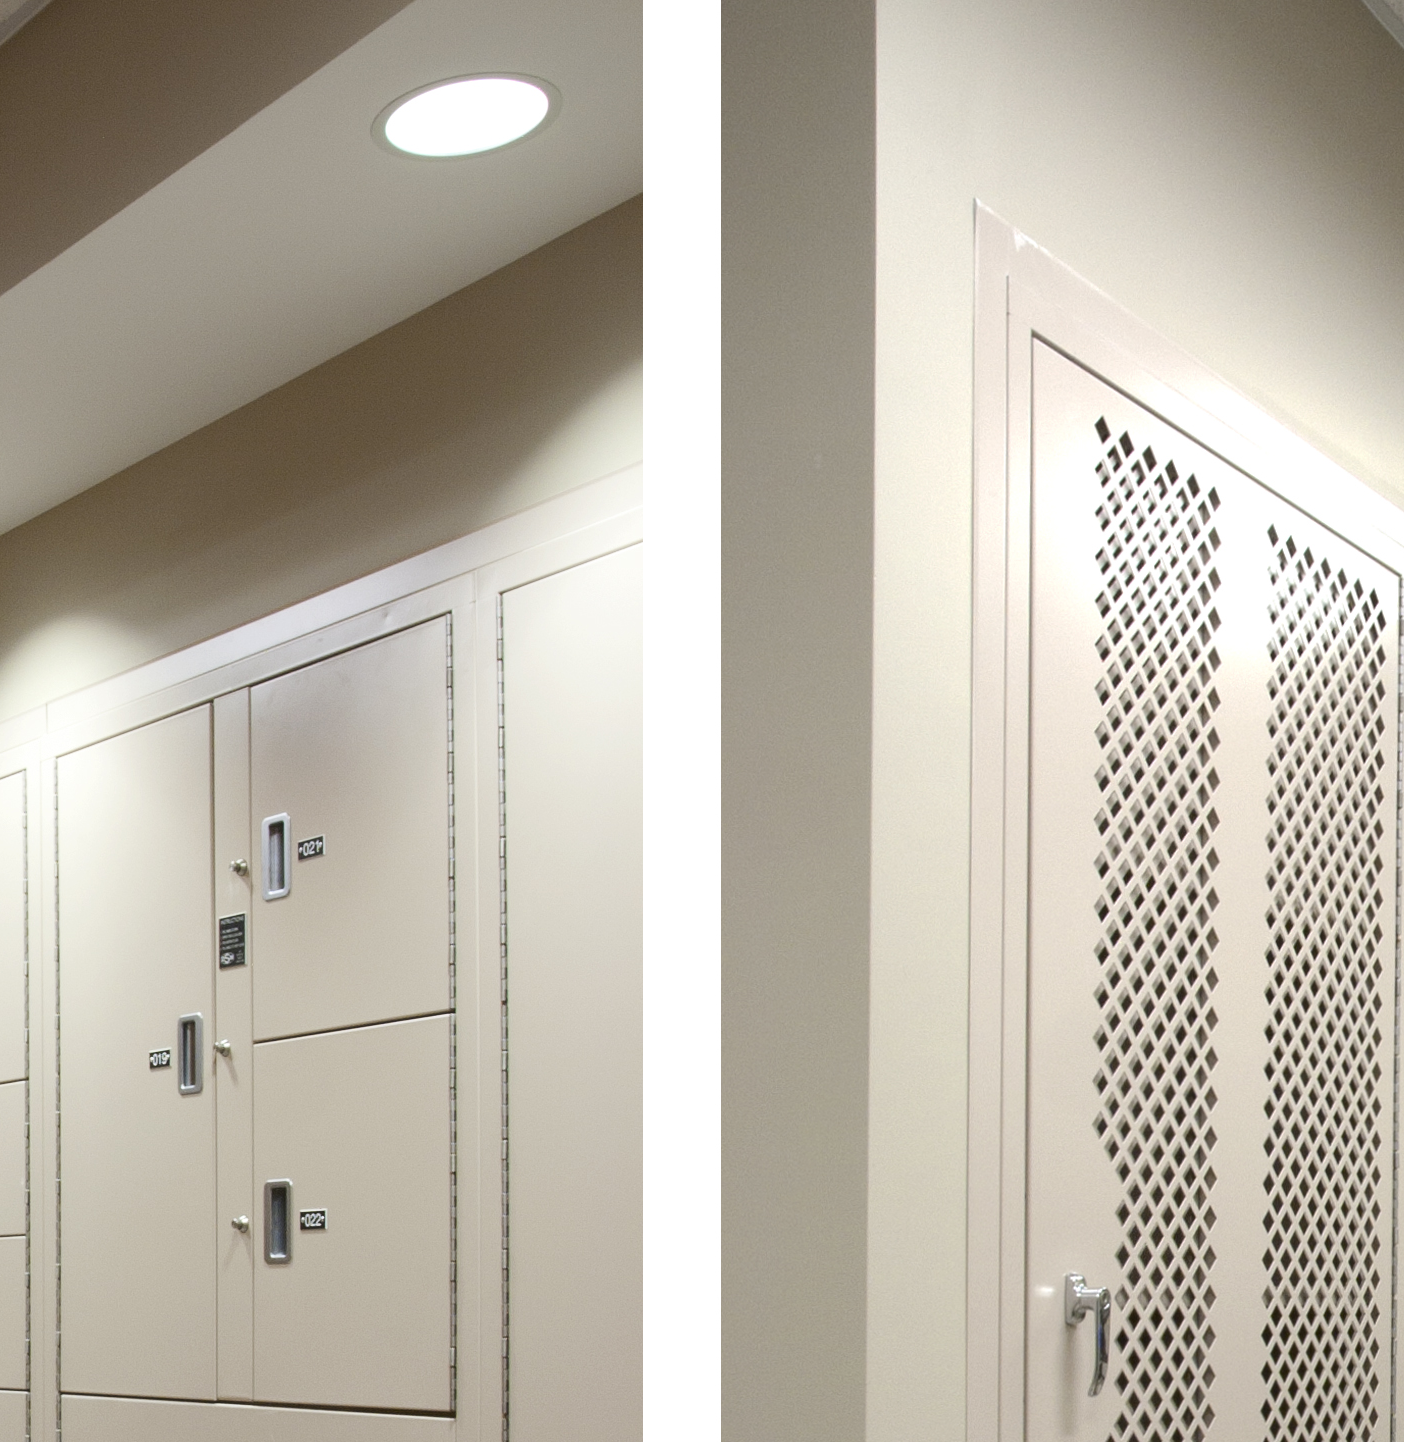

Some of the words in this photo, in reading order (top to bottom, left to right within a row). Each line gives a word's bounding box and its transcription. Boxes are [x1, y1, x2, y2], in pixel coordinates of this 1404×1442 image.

[302, 839, 320, 856] 021
[152, 1052, 167, 1066] 019
[304, 1213, 322, 1227] 022
